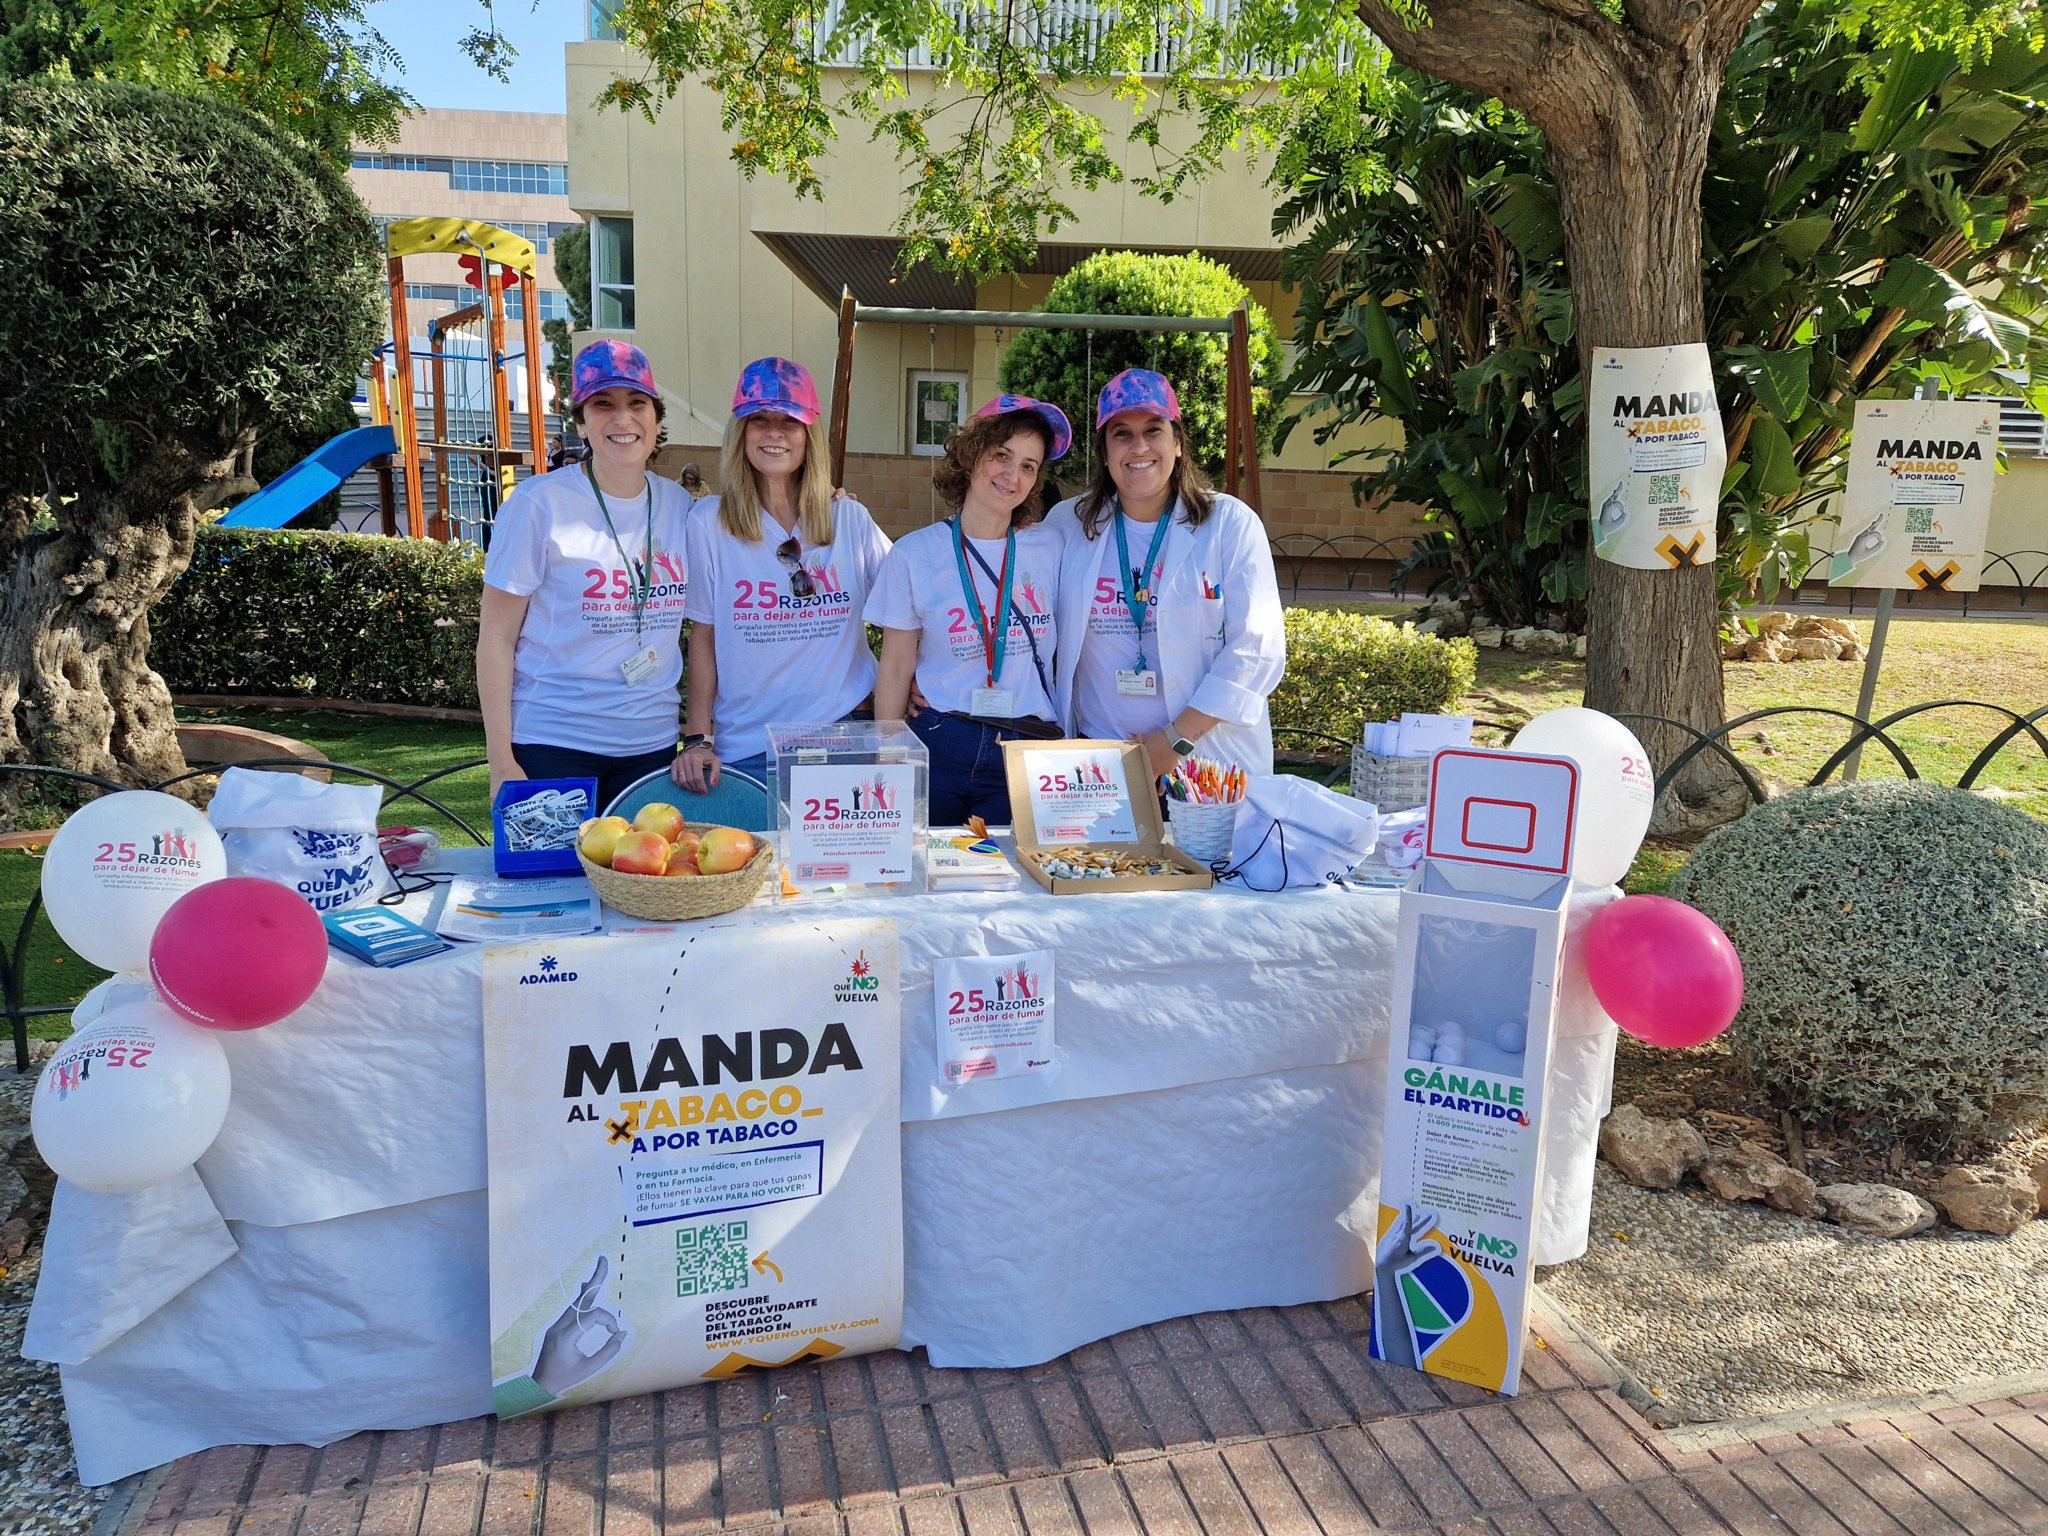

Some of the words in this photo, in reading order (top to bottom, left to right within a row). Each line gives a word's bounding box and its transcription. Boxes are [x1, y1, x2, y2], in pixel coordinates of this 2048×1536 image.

[1613, 390, 1716, 418] MANDA
[1667, 432, 1699, 441] TABACO
[1876, 440, 1981, 460] MANDA
[583, 569, 629, 599] 25
[733, 580, 778, 608] 25
[779, 591, 849, 608] Razones
[582, 602, 611, 611] para
[646, 601, 660, 609] de
[734, 612, 759, 621] para
[764, 610, 795, 621] dejar
[800, 609, 814, 618] de
[818, 607, 850, 616] fumar
[950, 634, 974, 644] para
[1621, 757, 1646, 778] 25
[1039, 775, 1068, 791] 25
[1069, 783, 1117, 791] Razones
[804, 799, 840, 820] 25
[841, 809, 901, 820] Razones
[829, 822, 853, 830] dejar
[95, 843, 136, 862] 25
[138, 854, 201, 868] Razones
[93, 864, 116, 872] para
[121, 864, 150, 873] dejar
[172, 867, 198, 877] fumar
[324, 869, 334, 879] Y
[298, 881, 334, 893] QUE
[520, 971, 577, 985] ADAMED
[853, 976, 879, 990] NO
[835, 993, 878, 1002] VUELVA
[949, 990, 984, 1015] 25
[985, 997, 1044, 1012] Razones
[949, 1016, 970, 1026] para
[973, 1013, 998, 1023] dejar
[1002, 1012, 1014, 1020] de
[1018, 1009, 1044, 1019] fumar
[97, 1039, 125, 1047] dejar
[130, 1040, 155, 1048] para
[49, 1048, 107, 1074] Razones
[107, 1047, 152, 1068] 25
[564, 1023, 863, 1098] MANDA
[1404, 1066, 1524, 1106] GÁNALE
[567, 1104, 599, 1123] AL
[1405, 1088, 1425, 1104] EL
[1430, 1093, 1523, 1123] PARTIDO
[631, 1138, 647, 1154] A
[653, 1131, 699, 1152] POR
[709, 1119, 797, 1145] TABACO
[1427, 1130, 1441, 1138] Dejar
[1453, 1135, 1470, 1143] fumar
[1452, 1123, 1483, 1134] personas
[1426, 1136, 1447, 1144] partido
[637, 1168, 678, 1180] Pregunta
[702, 1161, 738, 1172] médico,
[755, 1152, 801, 1165] Enfermería
[1424, 1160, 1449, 1168] personal
[1461, 1167, 1492, 1178] enfermería
[637, 1192, 660, 1202] ¡Ellos
[664, 1188, 691, 1198] tienen
[705, 1184, 727, 1192] clave
[731, 1182, 749, 1192] para
[753, 1180, 768, 1189] que
[787, 1173, 811, 1184] ganas
[672, 1175, 716, 1186] Farmacia.
[637, 1203, 648, 1212] de
[651, 1201, 677, 1210] fumar
[680, 1198, 690, 1206] SE
[694, 1195, 723, 1204] VAYAN
[726, 1192, 749, 1200] PARA
[752, 1189, 765, 1198] NO
[768, 1184, 804, 1195] VOLVER!
[1422, 1188, 1456, 1199] encestando
[1481, 1200, 1505, 1210] canasta
[1423, 1182, 1454, 1193] Demuestra
[1495, 1197, 1516, 1207] dejarlo
[1422, 1194, 1453, 1205] mandando
[1461, 1202, 1482, 1211] tabaco
[1501, 1211, 1522, 1220] tabaco
[1468, 1230, 1475, 1238] Y
[1449, 1234, 1474, 1248] QUE
[1477, 1233, 1517, 1259] NO
[1449, 1247, 1515, 1277] VUELVA
[706, 1295, 769, 1312] DESCUBRE
[706, 1309, 746, 1322] CÓMO
[750, 1299, 817, 1315] OLVIDARTE
[706, 1324, 727, 1332] DEL
[731, 1314, 782, 1329] TABACO
[706, 1326, 773, 1341] ENTRANDO
[777, 1323, 791, 1331] EN
